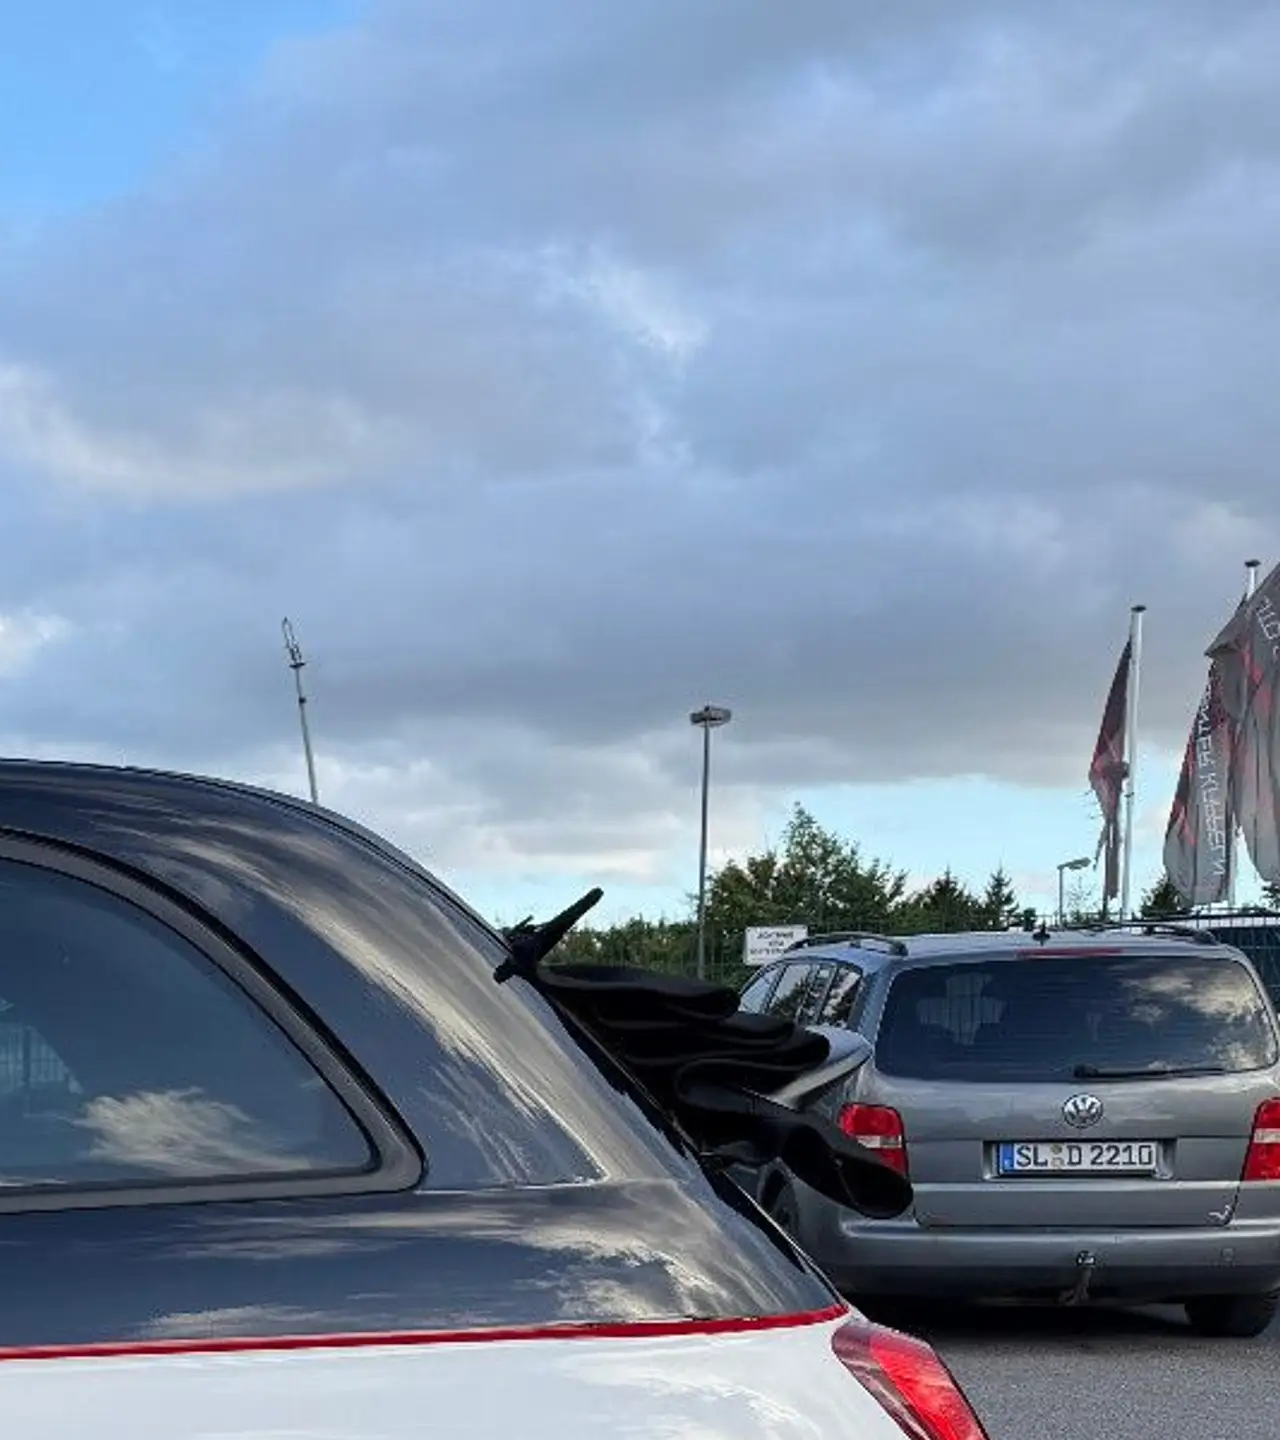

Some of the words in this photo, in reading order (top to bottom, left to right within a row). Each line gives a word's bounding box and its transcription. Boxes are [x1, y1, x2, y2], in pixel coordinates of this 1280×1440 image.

[1015, 1145, 1049, 1168] SL
[1066, 1145, 1083, 1167] D
[1090, 1144, 1153, 1167] 2210
